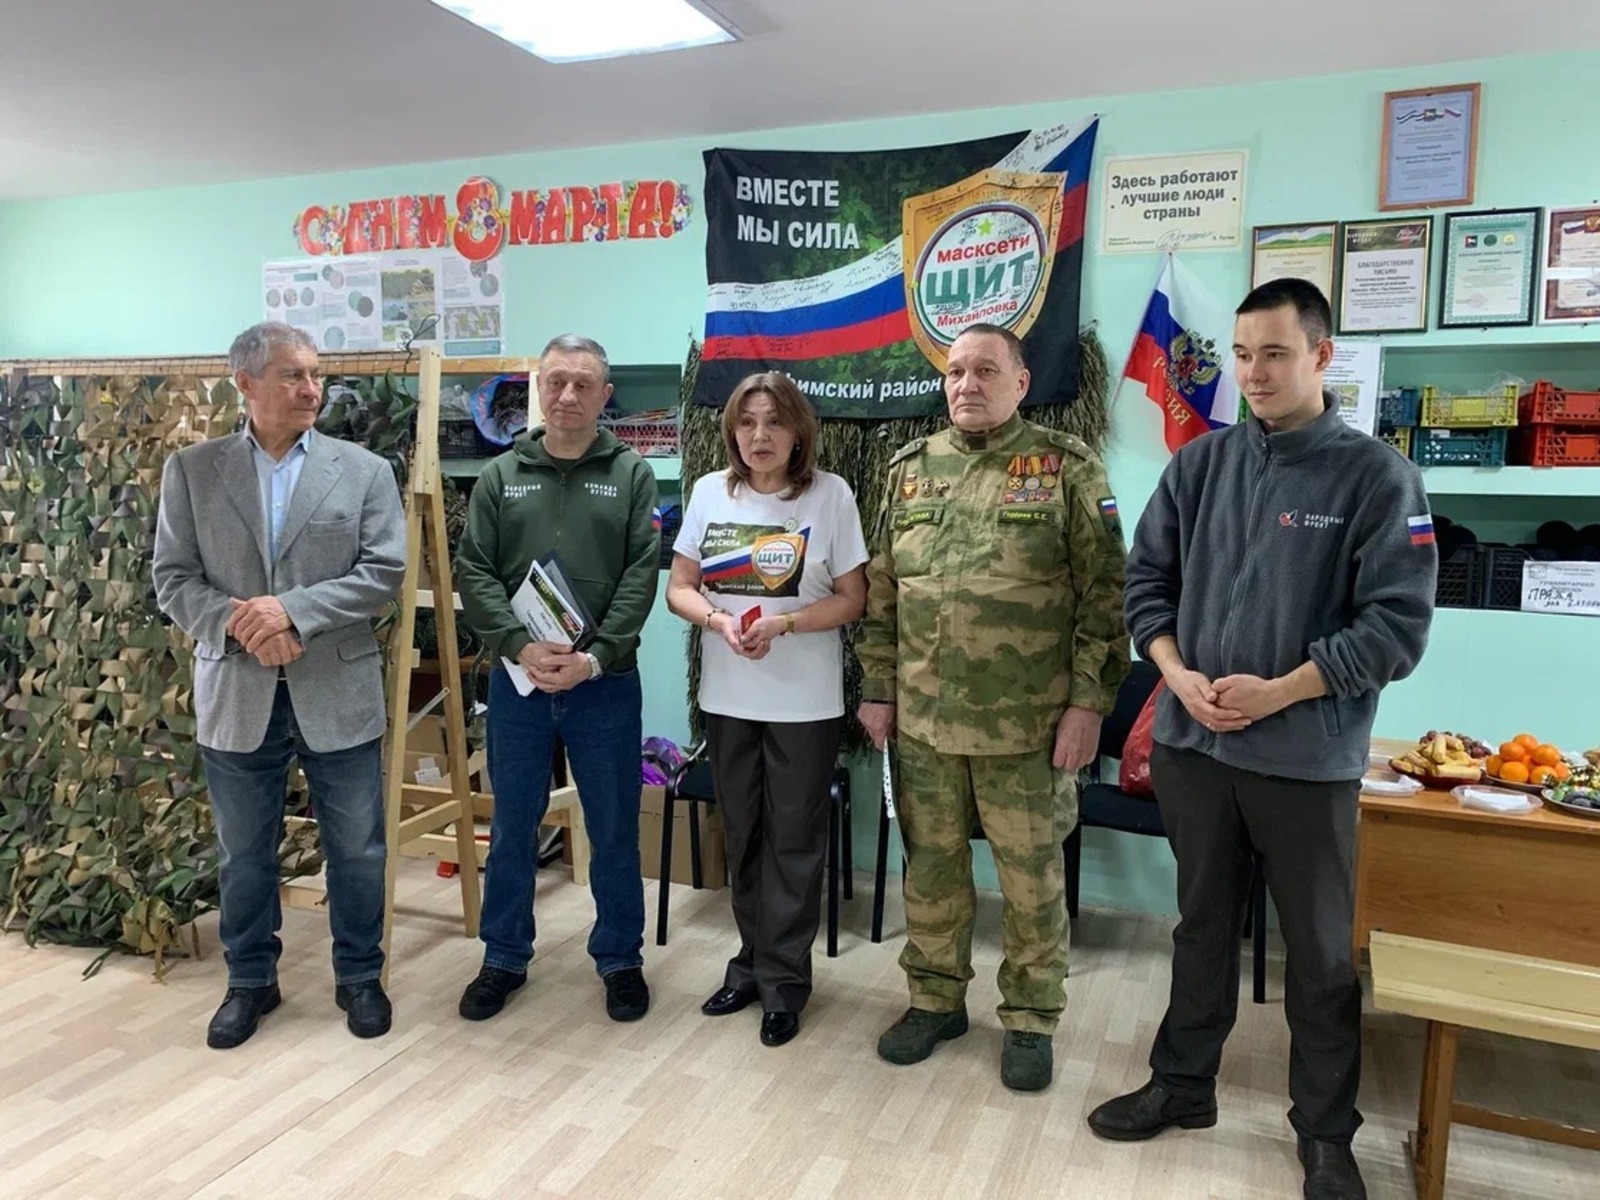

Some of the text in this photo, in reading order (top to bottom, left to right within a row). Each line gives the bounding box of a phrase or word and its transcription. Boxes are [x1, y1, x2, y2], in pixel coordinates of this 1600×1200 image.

[736, 175, 840, 207] ВМЕСТЕ
[1111, 170, 1238, 191] Здесь работают
[1121, 188, 1225, 207] лучшие люди
[301, 206, 331, 256] С
[454, 176, 502, 262] 8
[508, 180, 677, 246] МАРТА!
[1143, 206, 1201, 221] страны
[737, 214, 860, 249] МЫ СИЛА
[937, 234, 1031, 263] масксети
[926, 250, 1035, 309] ЩИТ
[936, 300, 1018, 327] Михайловка
[878, 375, 942, 402] район
[1304, 520, 1329, 529] ФРОНТ
[758, 553, 794, 565] ЩИТ
